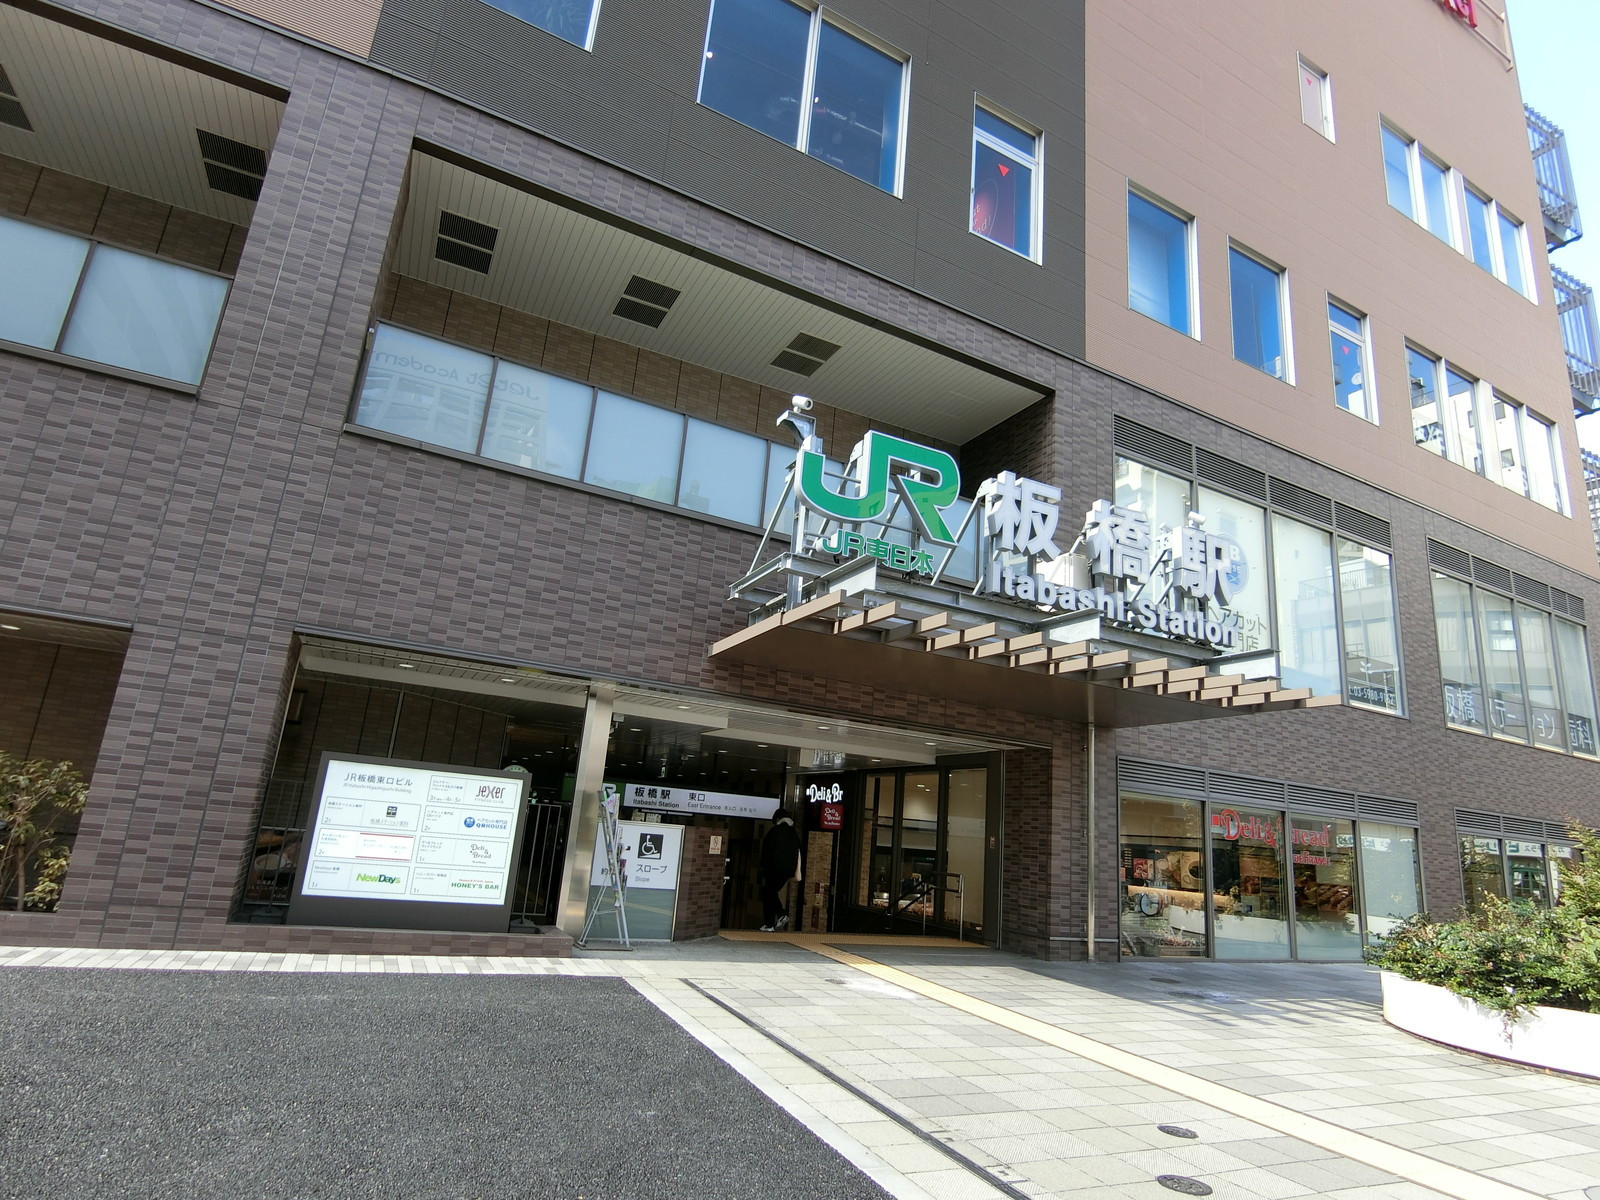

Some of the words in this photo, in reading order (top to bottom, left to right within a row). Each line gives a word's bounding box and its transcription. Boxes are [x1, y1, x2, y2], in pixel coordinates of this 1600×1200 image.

[798, 430, 961, 549] JR
[821, 529, 934, 577] JR東日本
[983, 469, 1234, 607] 板橋駅
[987, 560, 1127, 622] Itabashi
[1138, 599, 1238, 647] Station
[634, 787, 671, 800] 板橋駅
[690, 792, 706, 802] 東口
[1277, 817, 1330, 848] read
[356, 873, 401, 884] NewDays
[636, 864, 667, 874] スロープ
